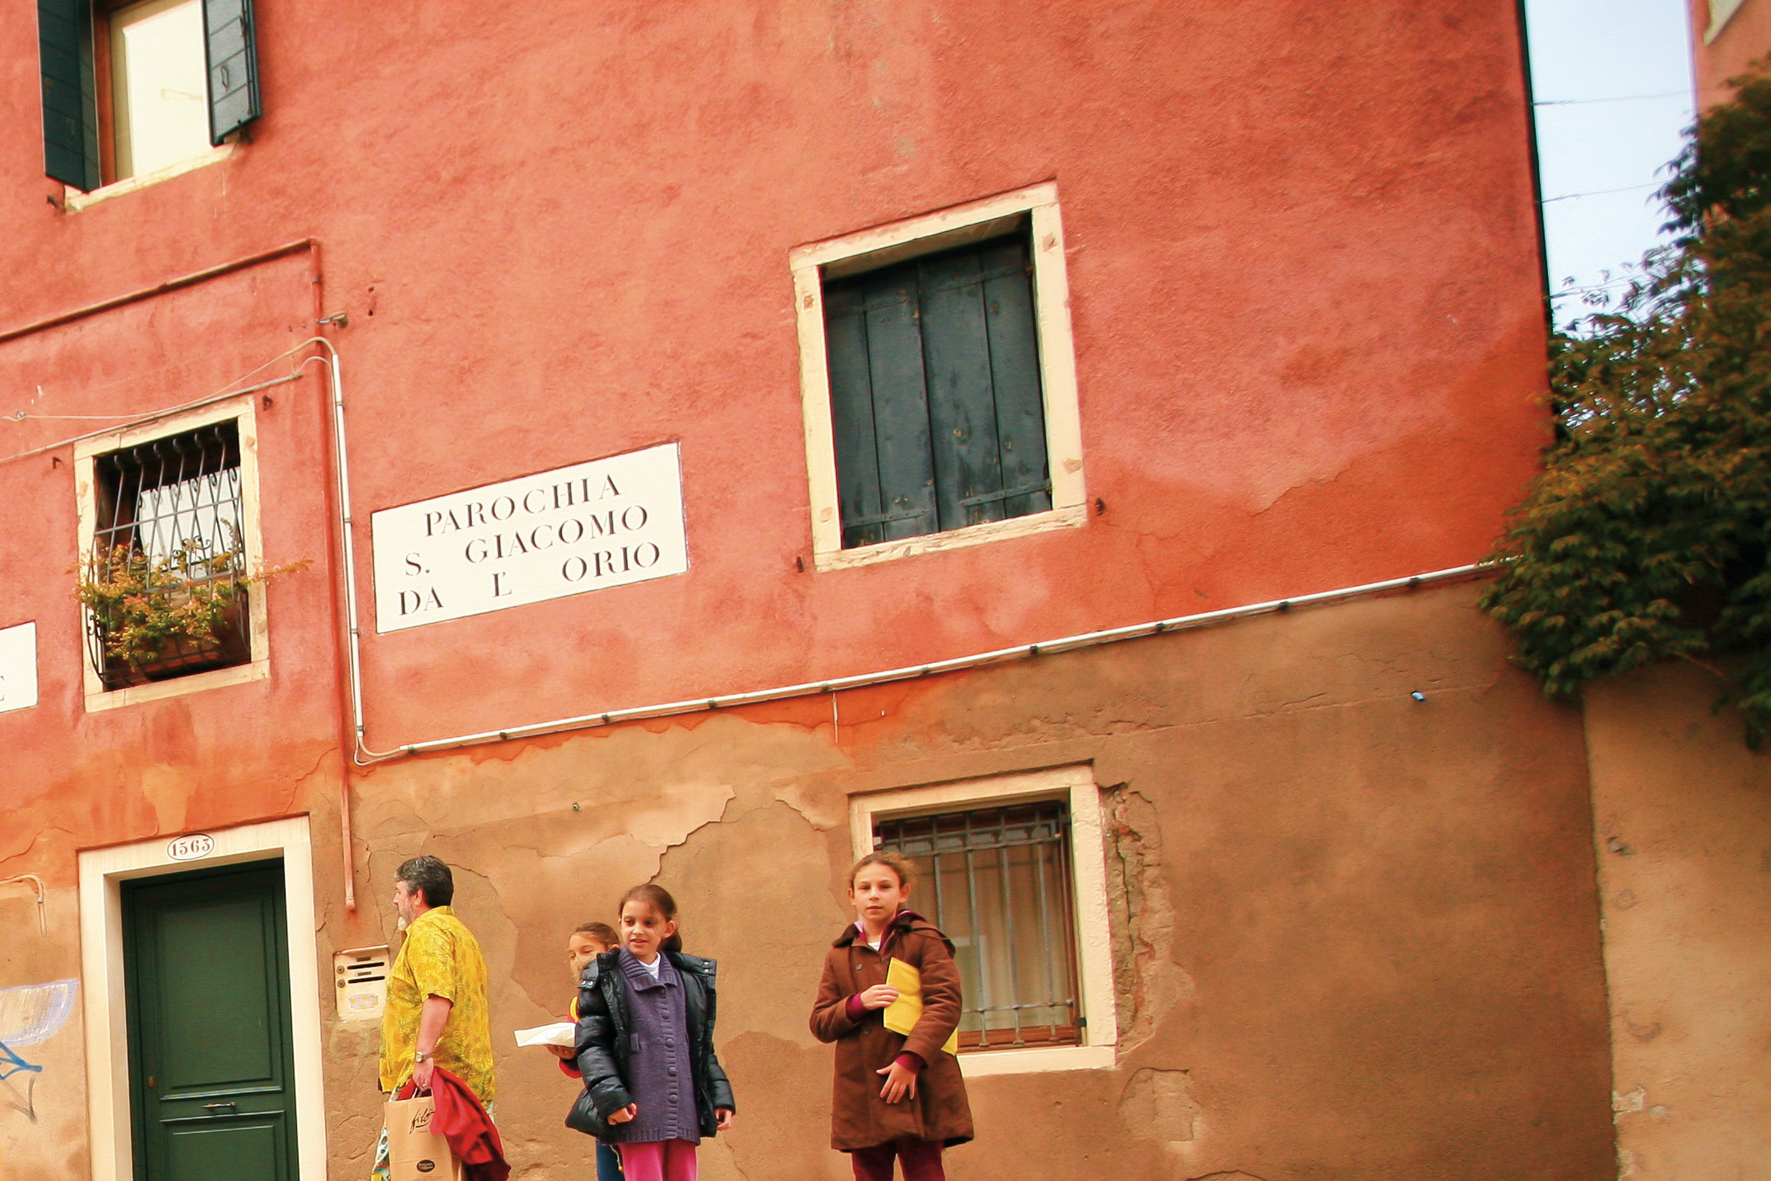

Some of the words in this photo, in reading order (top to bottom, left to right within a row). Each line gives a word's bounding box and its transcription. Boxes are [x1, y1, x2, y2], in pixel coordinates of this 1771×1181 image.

[424, 474, 621, 537] PAROCHIA
[405, 552, 431, 577] S.
[465, 505, 648, 564] GIACOMO
[399, 587, 444, 616] DA
[562, 541, 660, 582] ORIO
[172, 838, 211, 857] 1563
